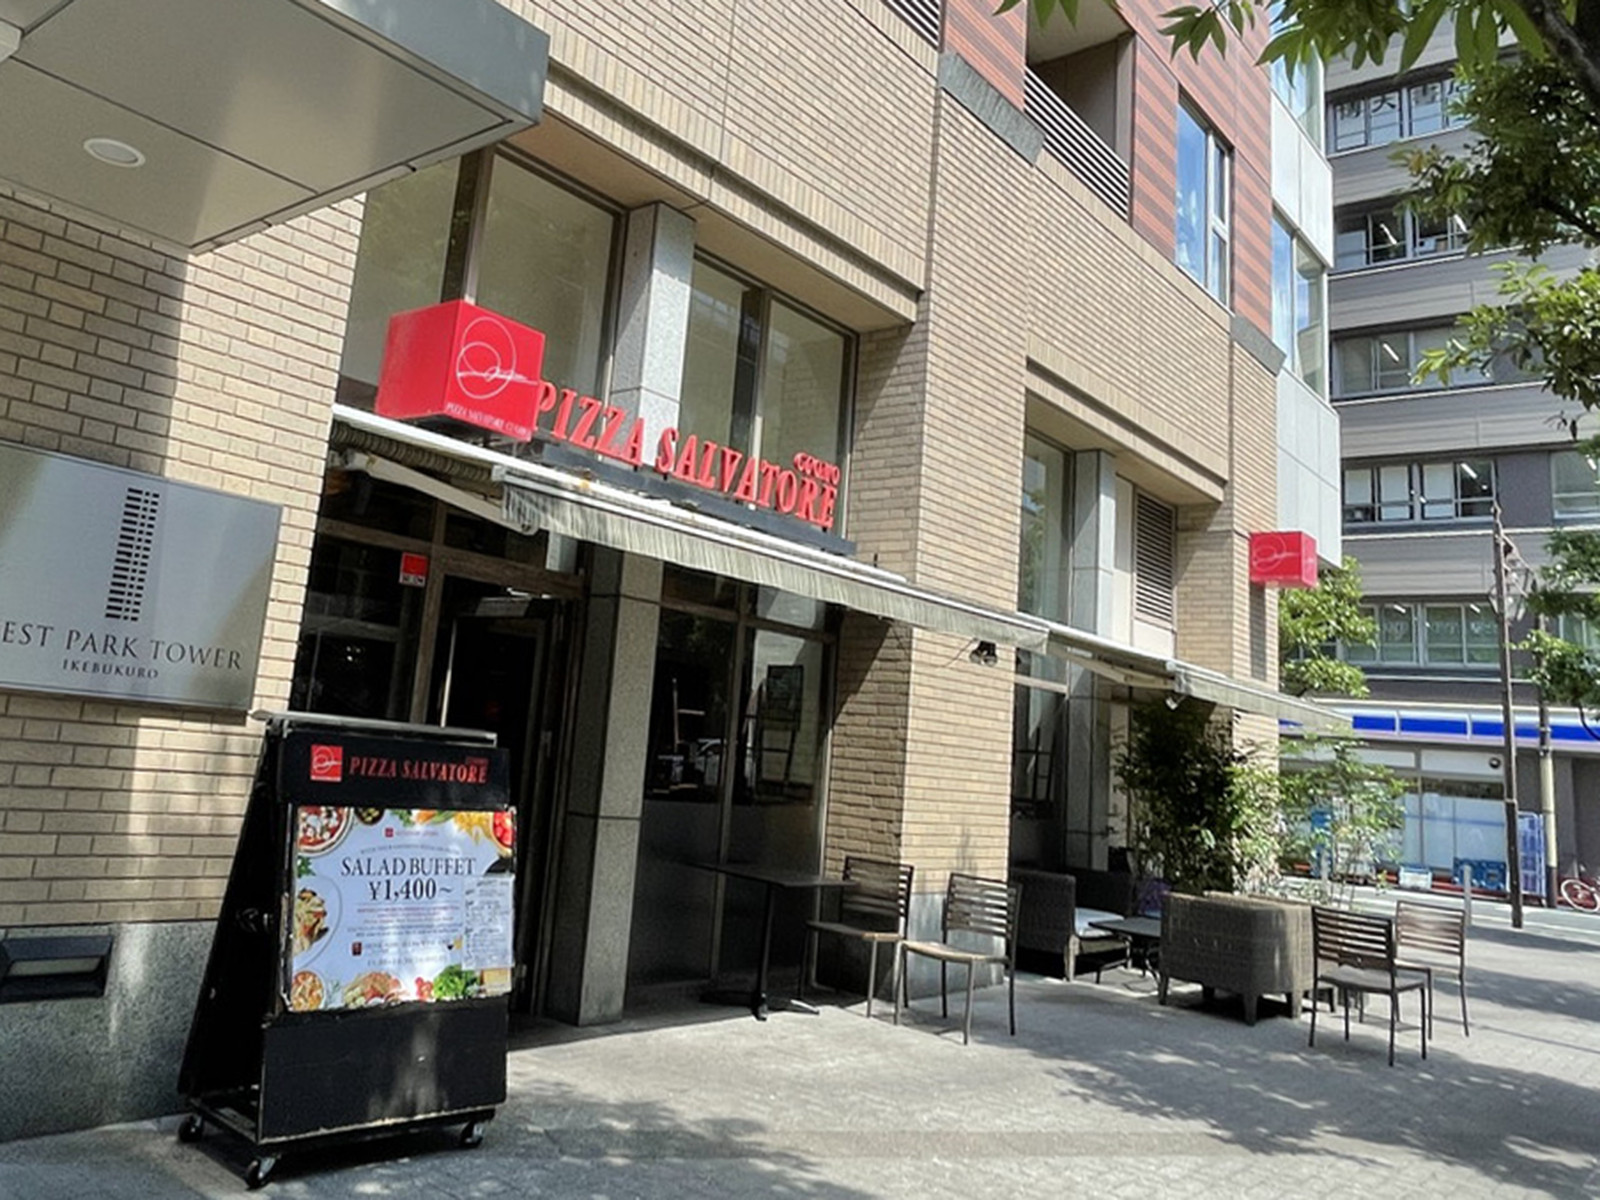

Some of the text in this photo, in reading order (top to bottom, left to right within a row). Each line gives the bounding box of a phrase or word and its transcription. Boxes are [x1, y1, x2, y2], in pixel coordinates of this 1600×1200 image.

[536, 380, 838, 529] PIZZA SALVATORE
[2, 621, 242, 670] EST PARK TOWER
[63, 659, 159, 679] IKEBUKURO
[350, 756, 397, 778] PIZZA
[401, 760, 488, 783] SALVATORE
[341, 857, 477, 877] SALAD BUFFET
